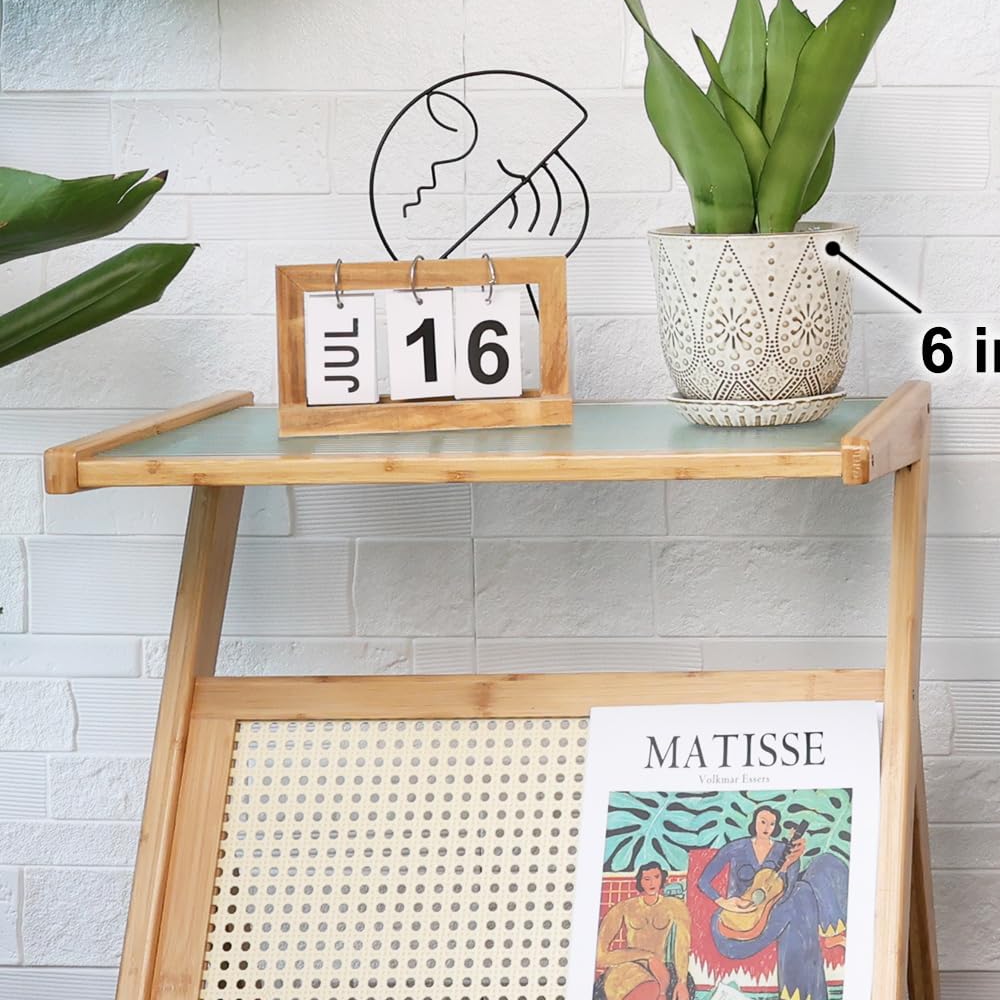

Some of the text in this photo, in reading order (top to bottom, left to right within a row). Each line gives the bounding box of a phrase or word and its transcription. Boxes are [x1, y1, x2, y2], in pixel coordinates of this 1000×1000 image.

[324, 317, 360, 393] JUL
[644, 731, 826, 769] MATISSE
[698, 773, 771, 785] Volkmar Essers
